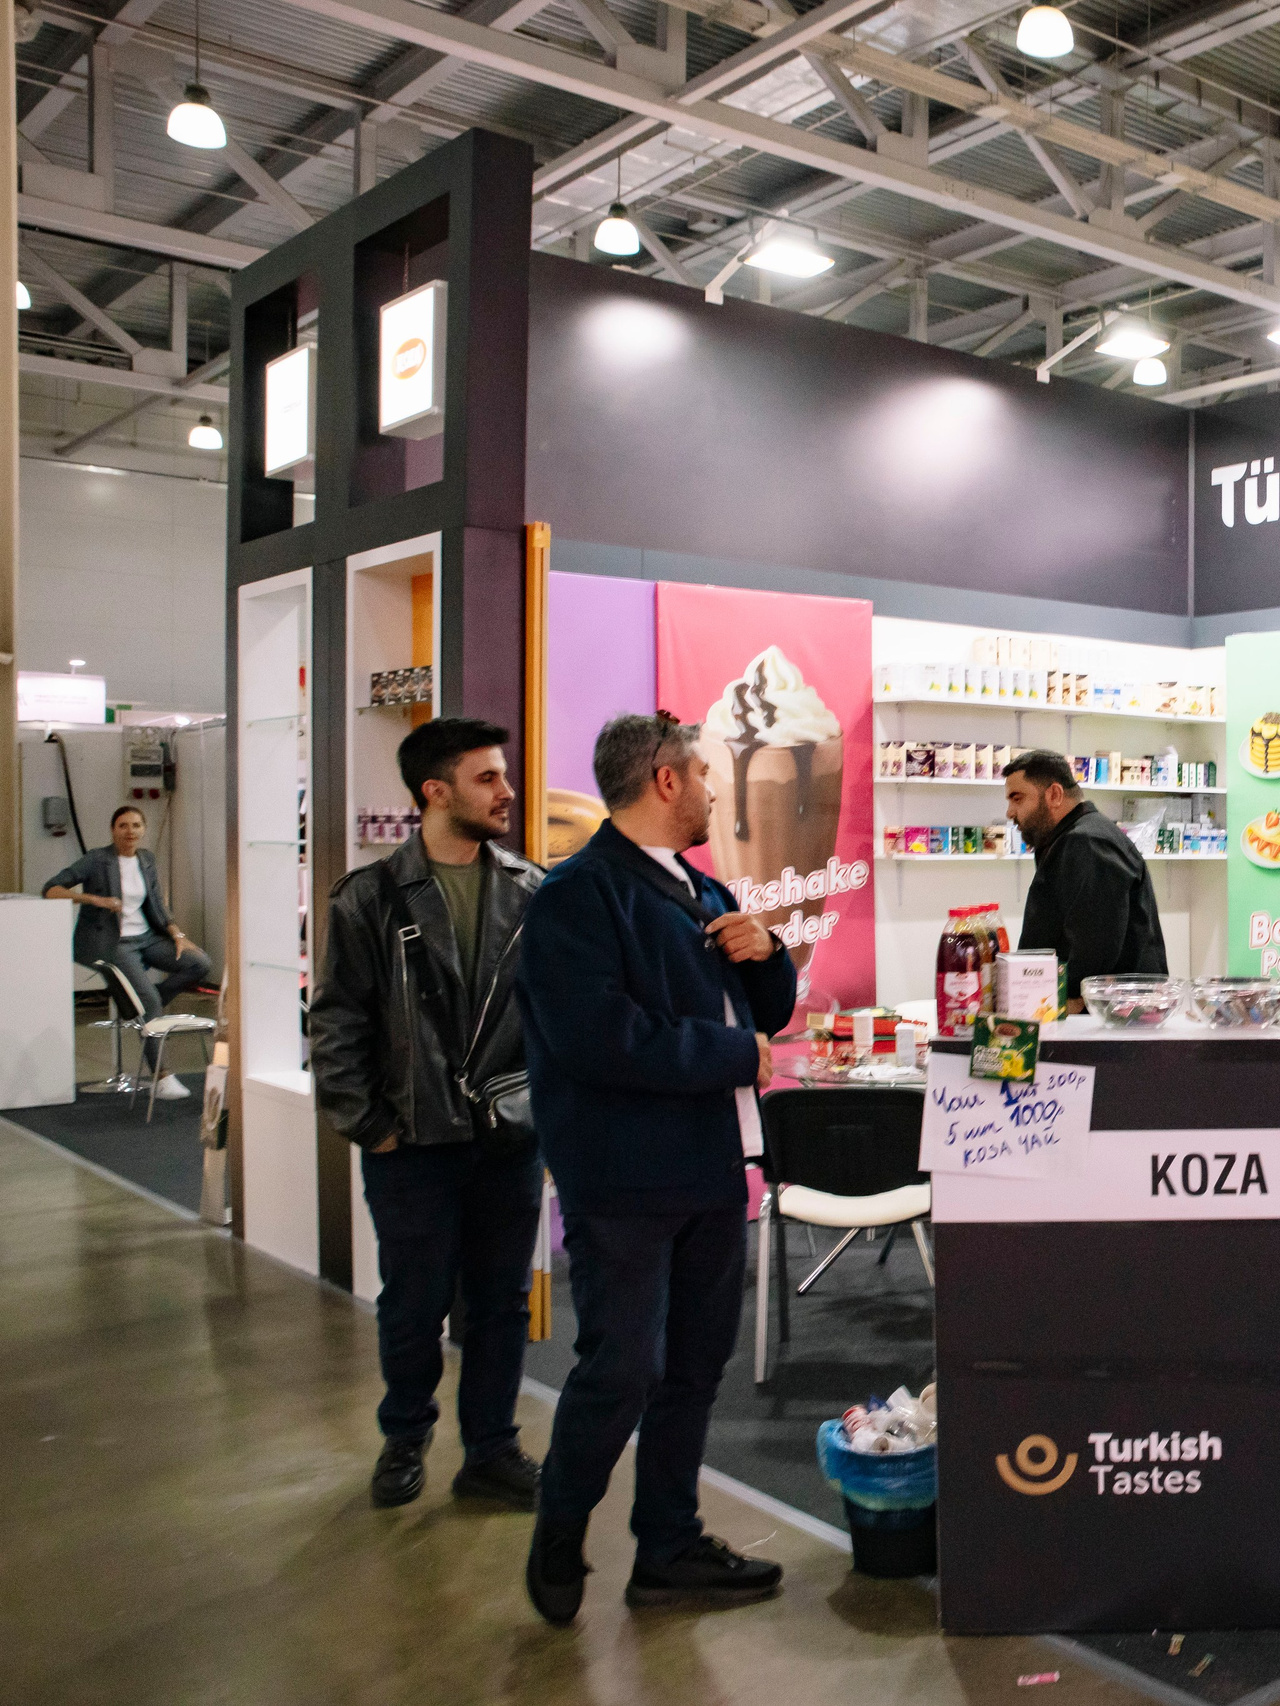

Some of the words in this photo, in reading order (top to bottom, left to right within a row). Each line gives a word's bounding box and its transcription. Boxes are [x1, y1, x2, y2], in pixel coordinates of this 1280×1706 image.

[944, 1121, 961, 1146] 5
[1150, 1153, 1270, 1197] KOZA
[1088, 1430, 1222, 1463] Turkish
[1089, 1464, 1203, 1496] Tastes
